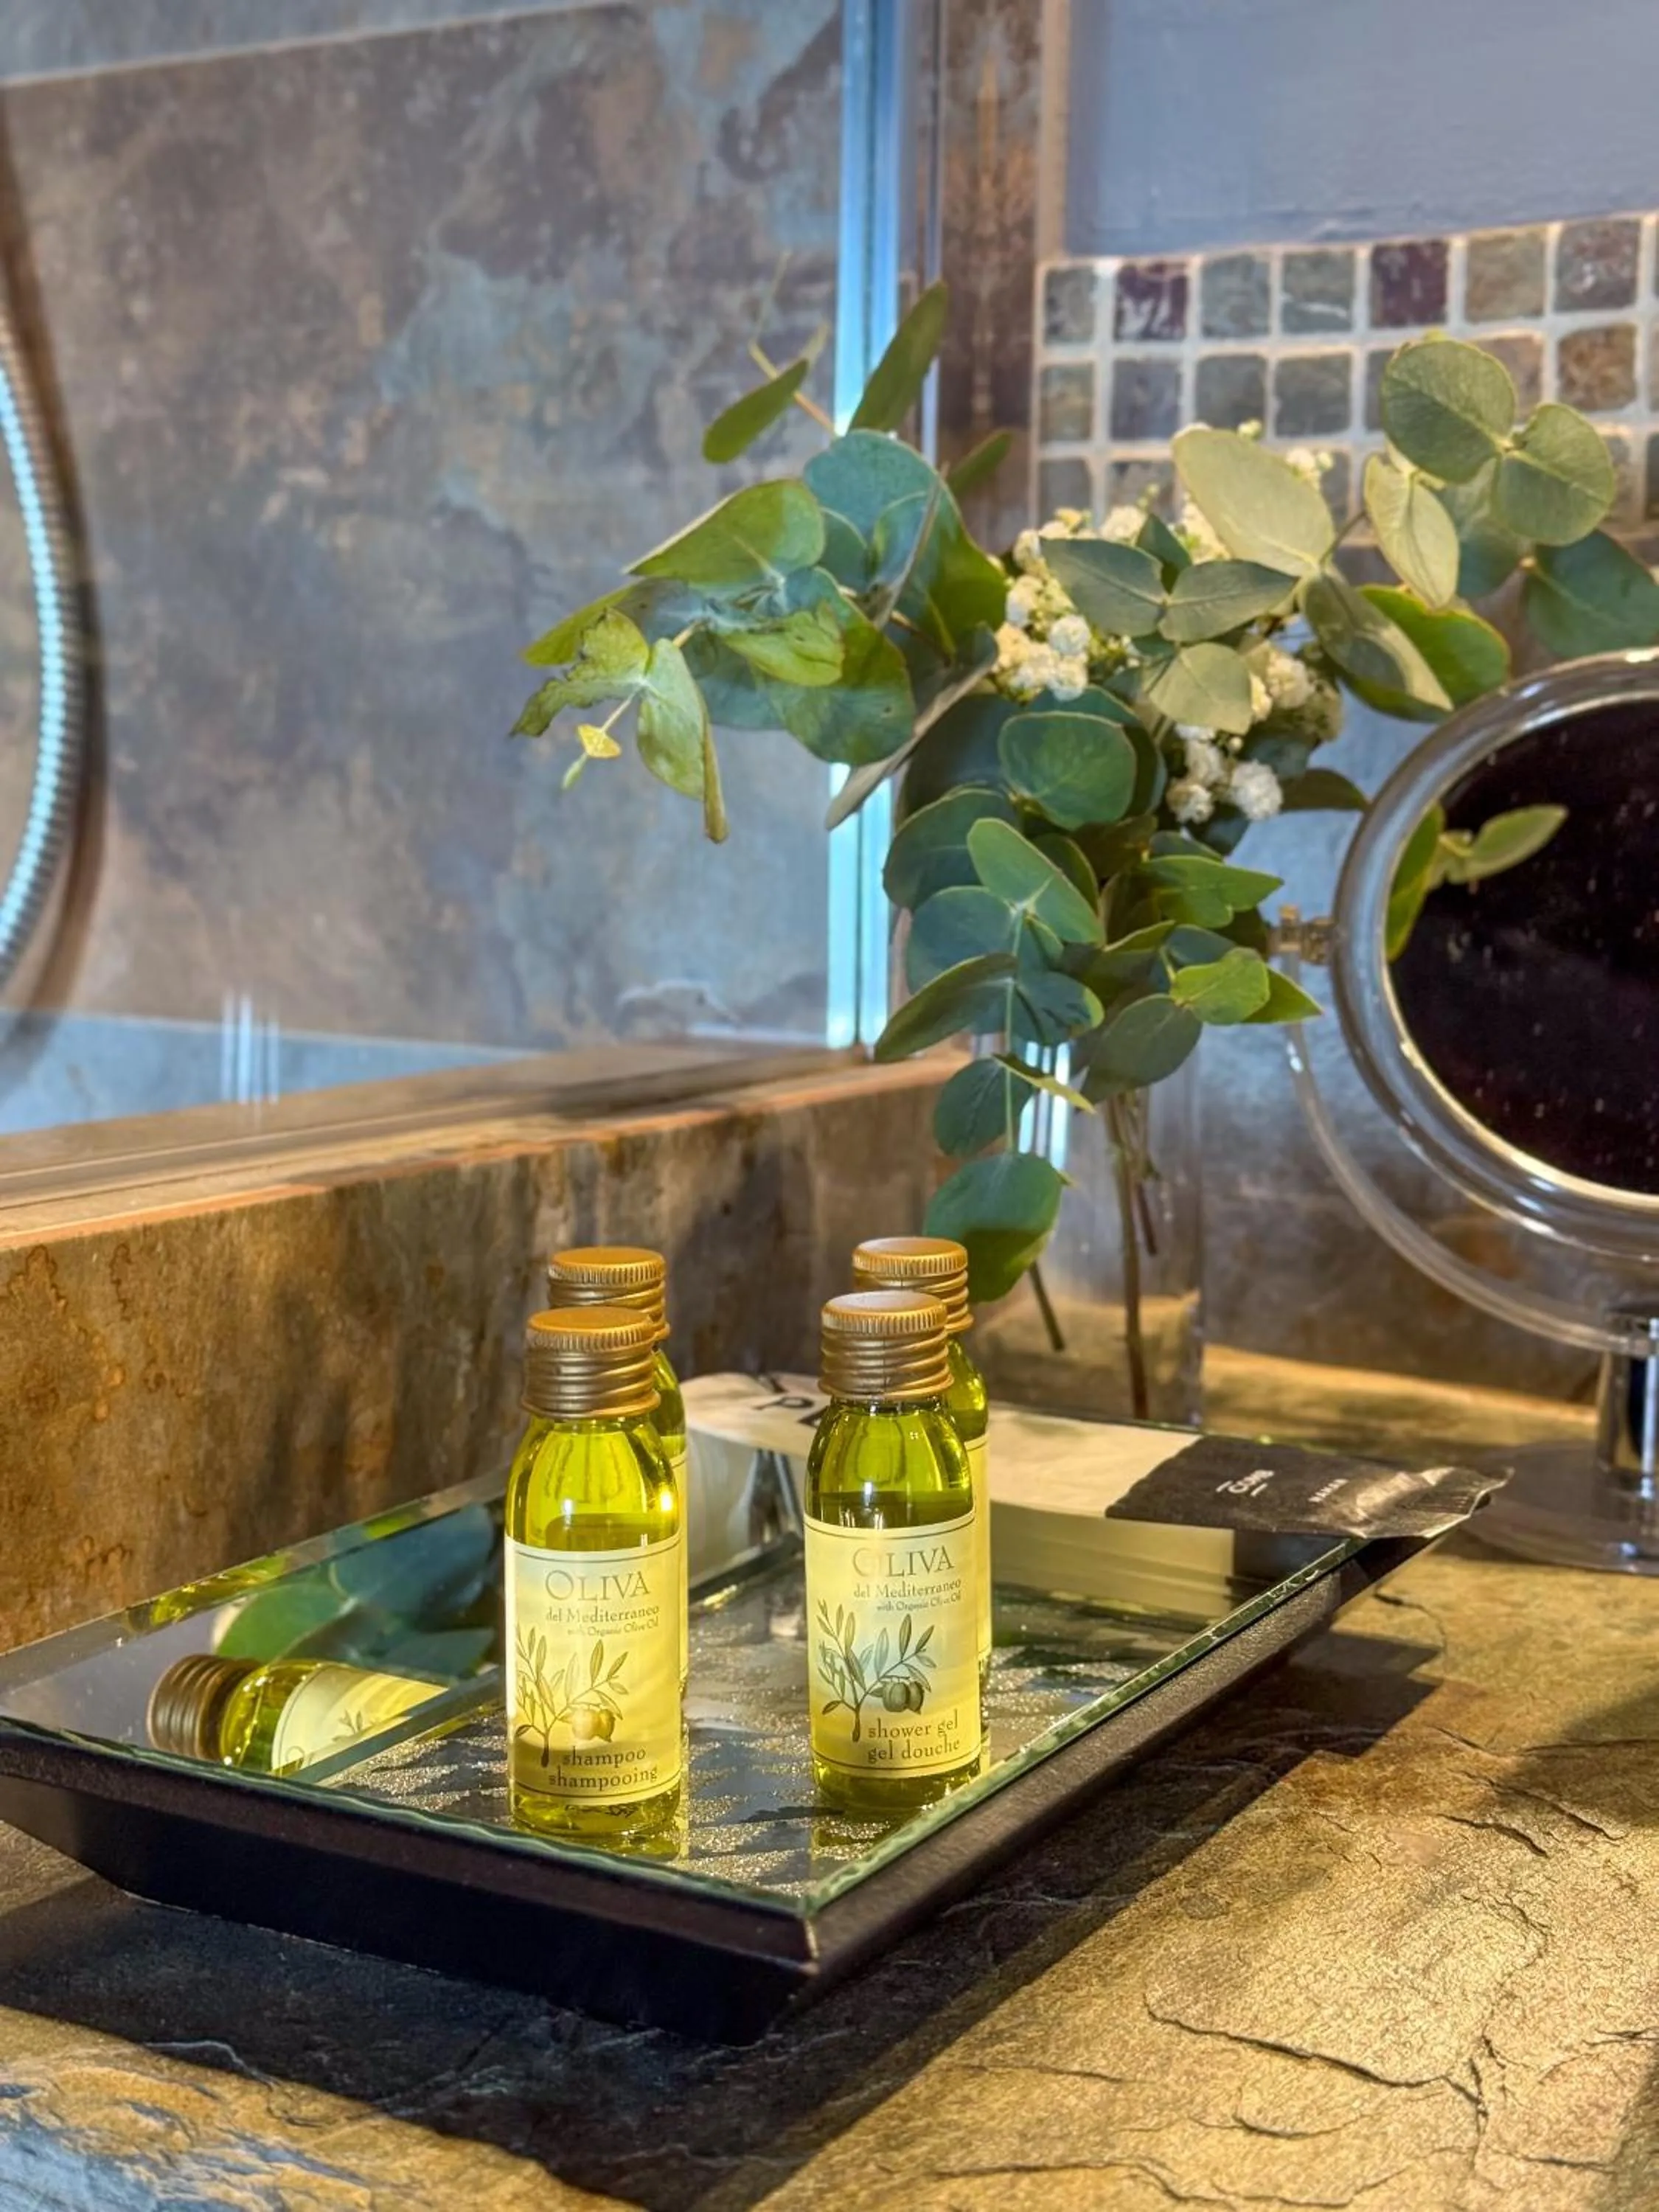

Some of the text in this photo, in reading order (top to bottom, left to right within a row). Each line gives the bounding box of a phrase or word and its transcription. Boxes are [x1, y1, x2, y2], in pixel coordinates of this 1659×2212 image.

[852, 1544, 956, 1578] OLIVA
[545, 1569, 651, 1601] OLIVA
[853, 1578, 961, 1598] del Mediterraneo
[546, 1604, 660, 1623] del Mediterraneo
[868, 1708, 958, 1738] shower gel
[562, 1745, 647, 1768] shampoo
[867, 1733, 961, 1764] gel douche
[548, 1764, 658, 1791] shampooing
